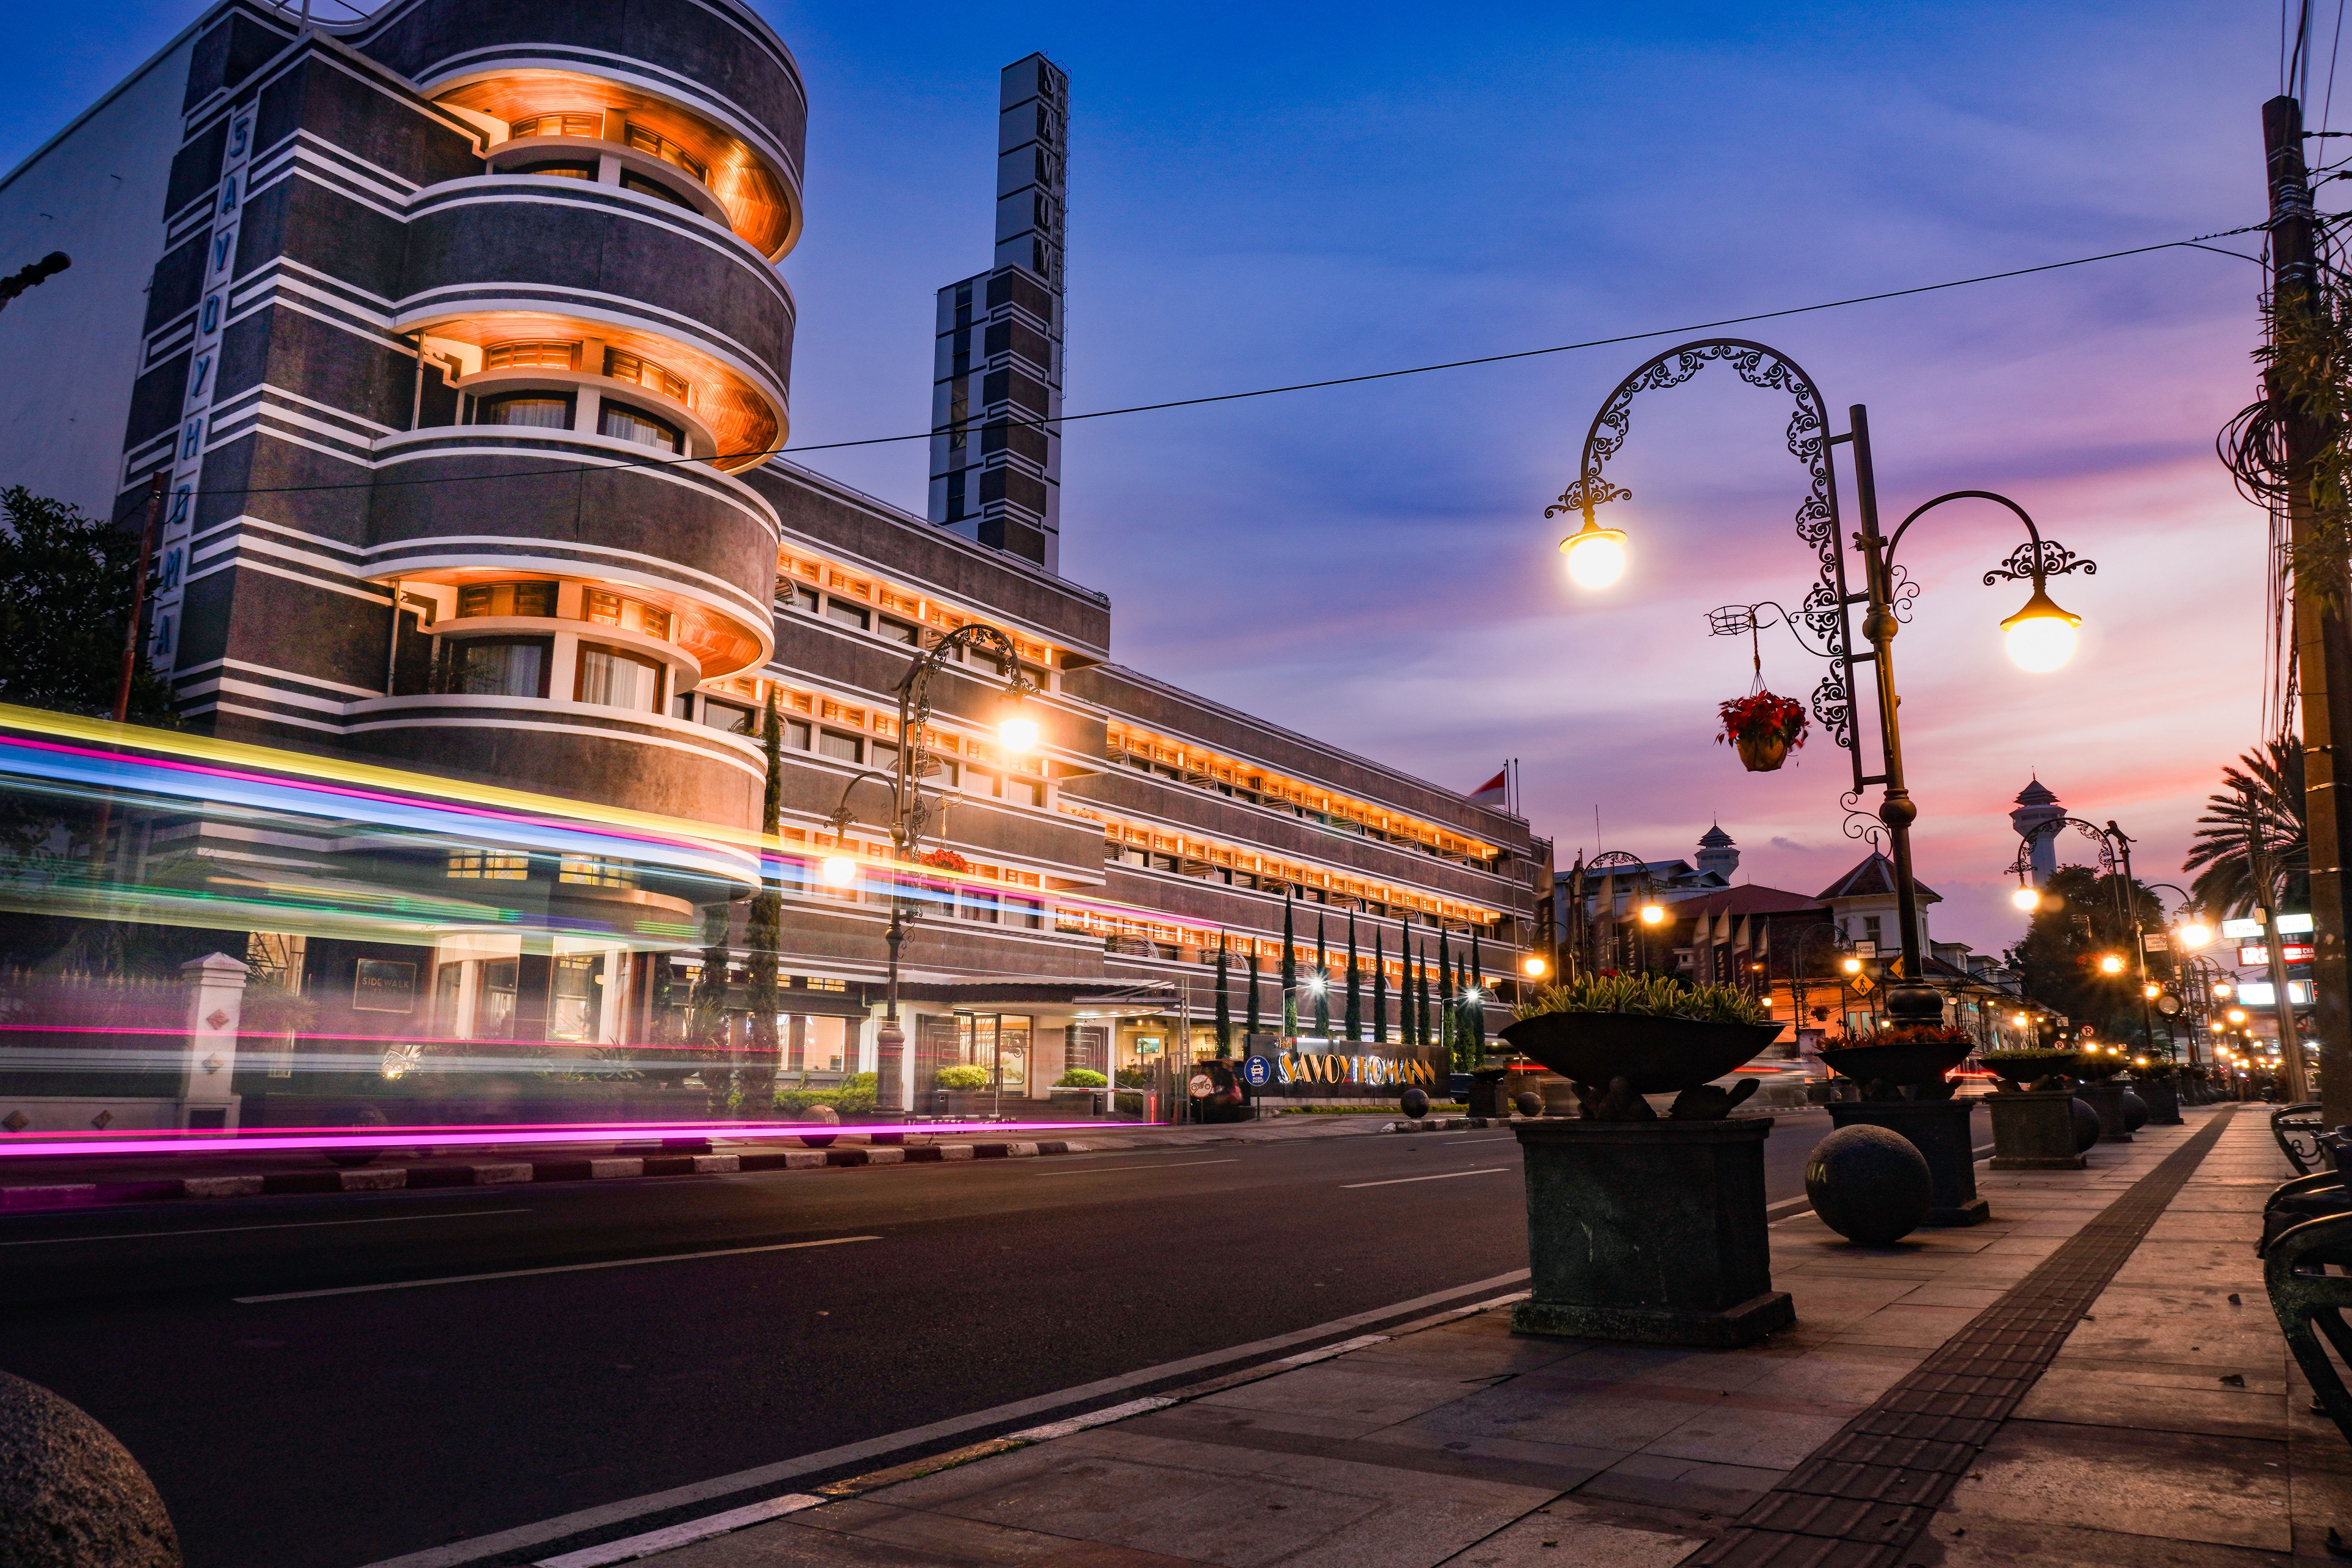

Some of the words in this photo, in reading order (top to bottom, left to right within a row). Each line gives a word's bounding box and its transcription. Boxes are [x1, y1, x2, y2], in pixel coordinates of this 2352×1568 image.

[1040, 66, 1055, 272] SAVOY
[193, 117, 249, 397] SAVOY
[362, 977, 409, 988] SIDEWALK
[1278, 1052, 1353, 1083] SAVOY
[1353, 1055, 1436, 1085] HOMANN
